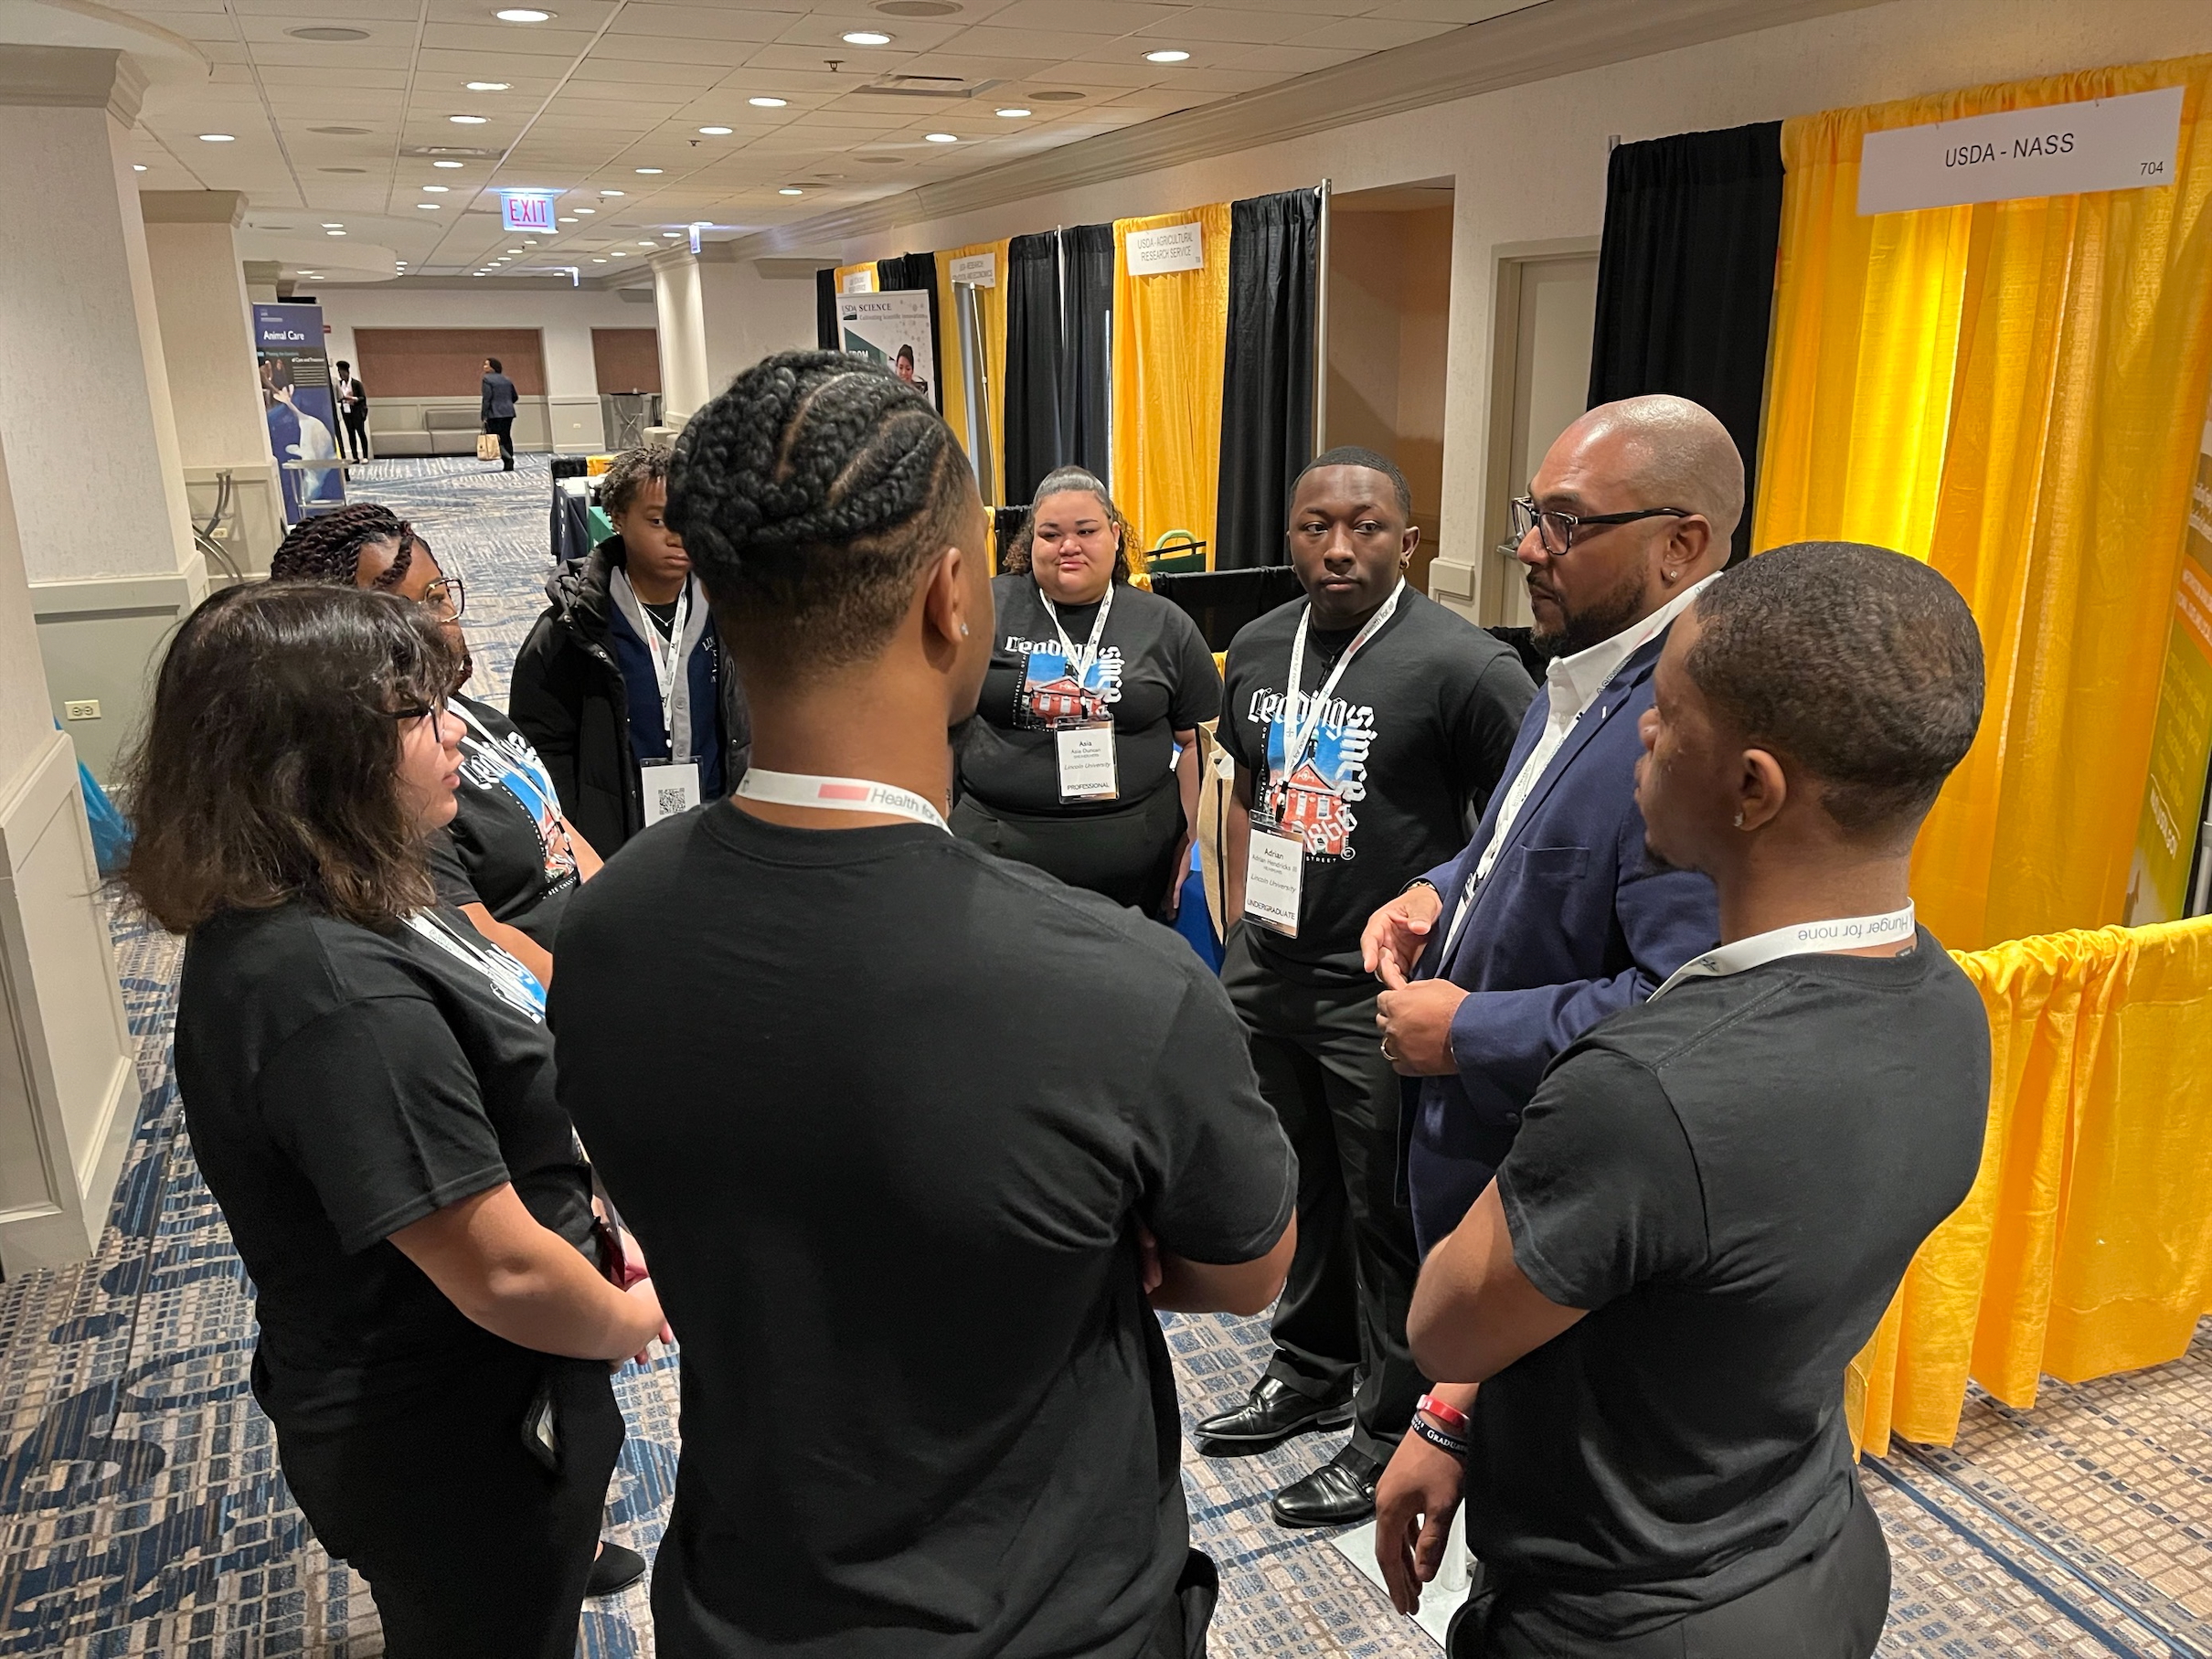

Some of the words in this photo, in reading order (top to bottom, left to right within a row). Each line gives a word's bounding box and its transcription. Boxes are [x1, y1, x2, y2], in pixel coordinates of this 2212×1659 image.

[1945, 143, 1995, 167] USDA
[2013, 133, 2074, 159] NASS
[2140, 161, 2164, 175] 704
[508, 198, 546, 222] EXIT
[1137, 238, 1154, 250] USDA
[1156, 232, 1193, 247] AGRICULTURAL
[1141, 249, 1169, 261] RESEARCH
[1170, 245, 1192, 259] SERVICE
[842, 304, 856, 313] USDA
[859, 303, 891, 312] SCIENCE
[263, 330, 287, 341] Animal
[287, 330, 305, 341] Care
[1363, 616, 1382, 637] Health
[1379, 609, 1389, 619] for
[1335, 704, 1378, 802] Since
[1067, 782, 1110, 791] PROFESSIONAL
[871, 787, 920, 813] Health
[920, 803, 935, 822] for
[1264, 847, 1284, 859] Adrian
[1251, 854, 1267, 863] Adrian
[1267, 858, 1292, 872] Hendricks
[1250, 873, 1269, 885] Lincoln
[1269, 879, 1297, 894] University
[1247, 898, 1296, 920] UNDERGRADUATE
[1798, 926, 1837, 941] none
[1842, 924, 1862, 940] for
[1866, 916, 1909, 934] Hunger
